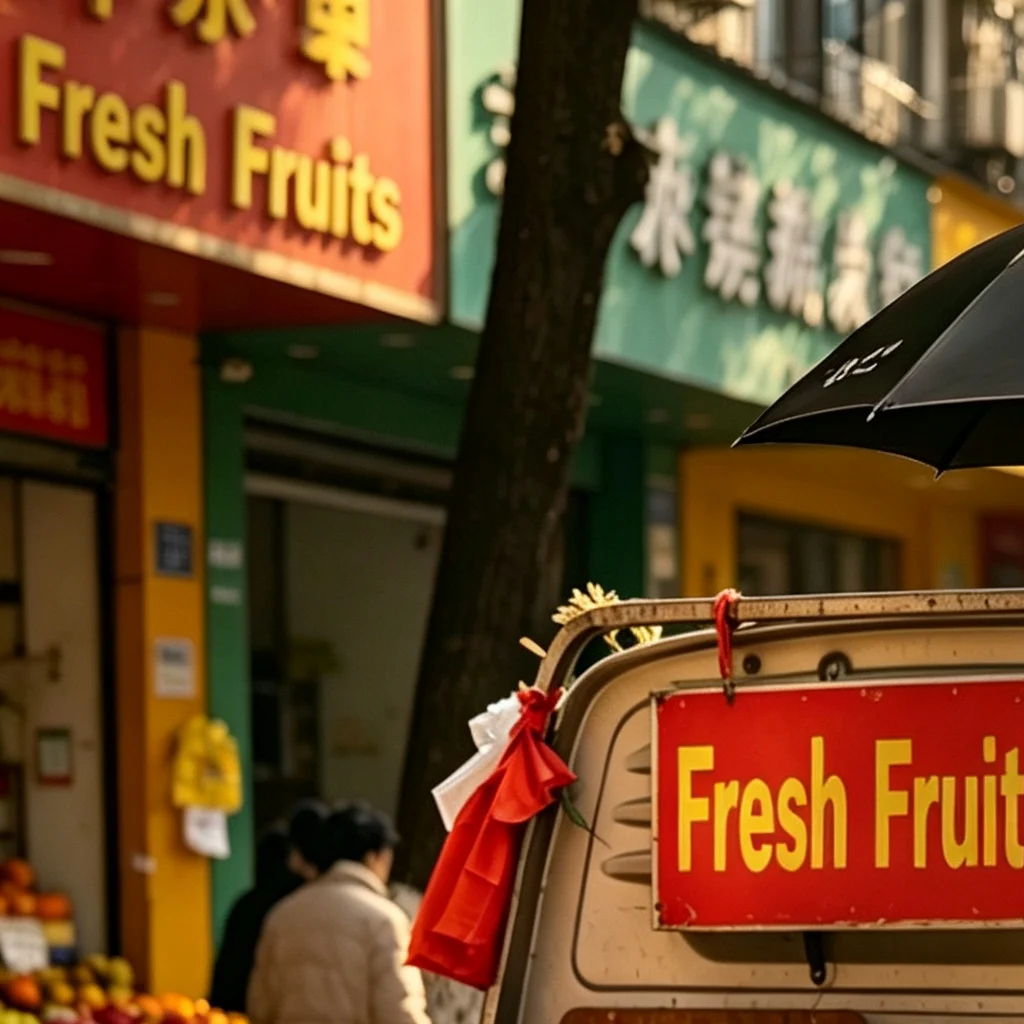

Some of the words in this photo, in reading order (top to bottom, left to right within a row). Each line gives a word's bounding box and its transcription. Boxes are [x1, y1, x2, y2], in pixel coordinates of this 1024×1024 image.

[20, 35, 206, 193] Fresh
[233, 104, 402, 250] Fruits
[678, 736, 847, 872] Fresh
